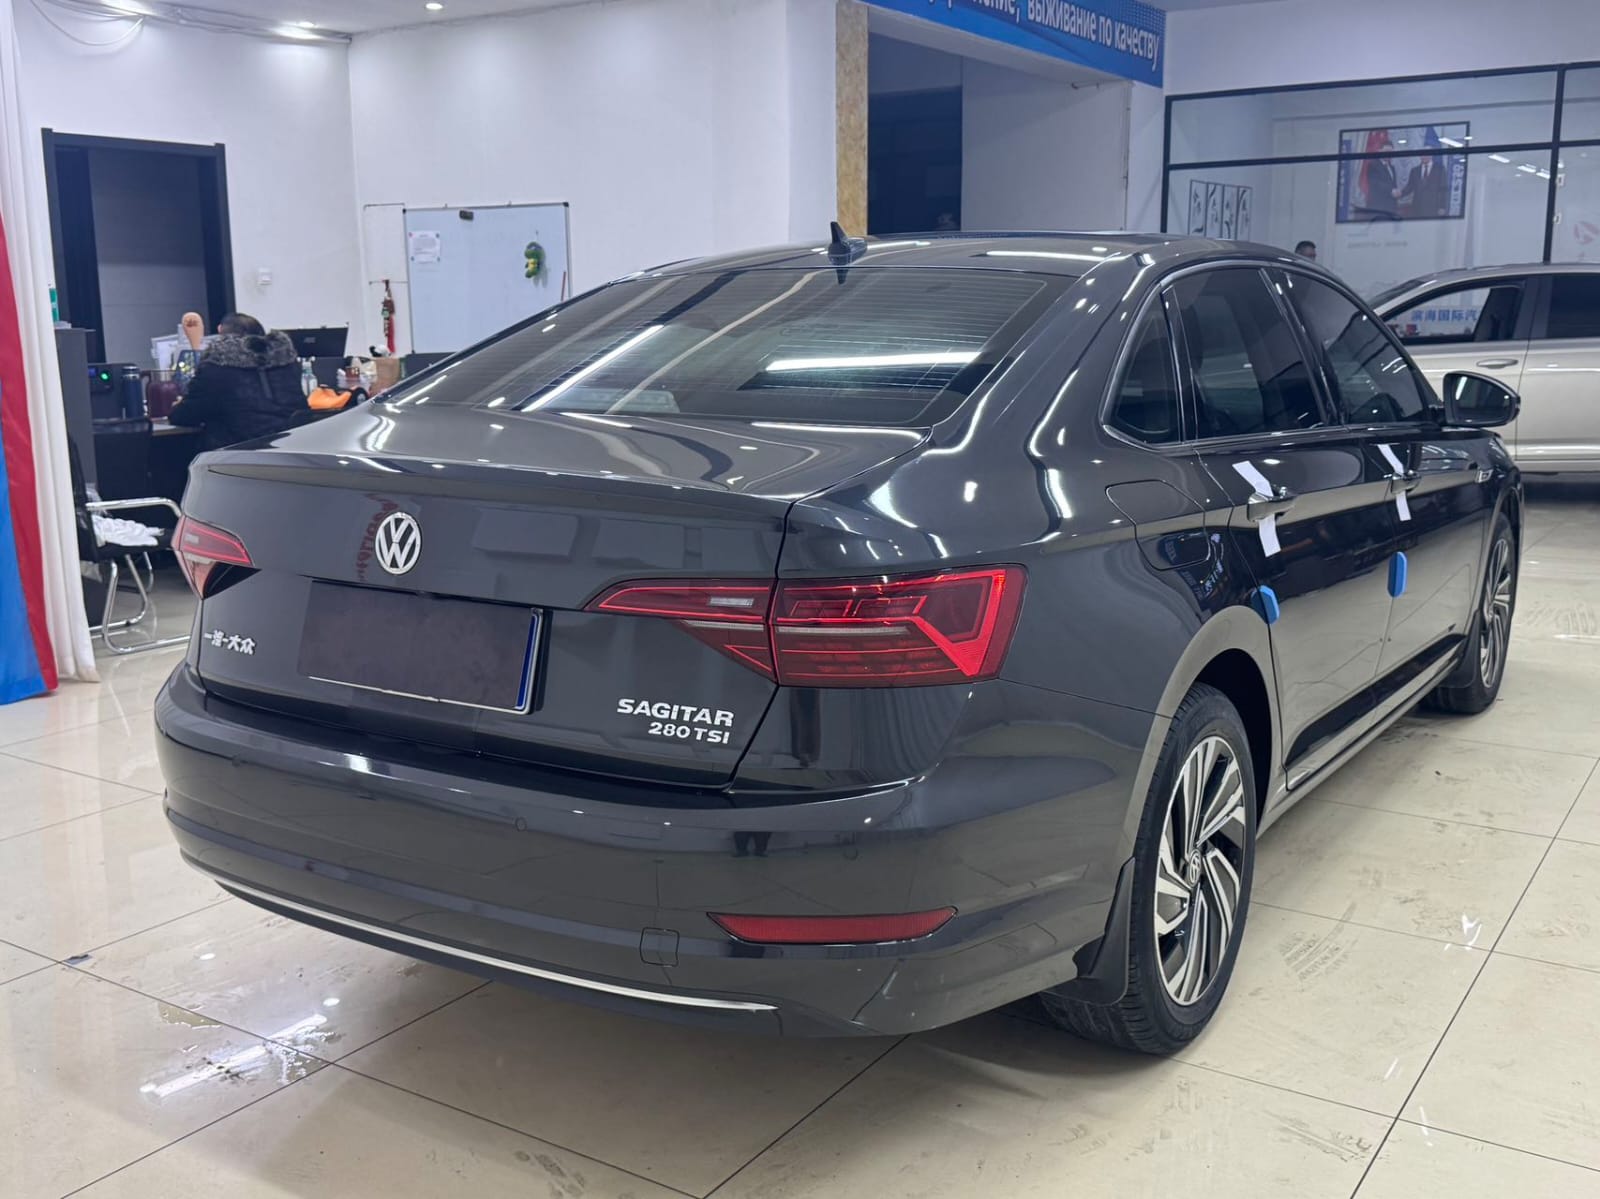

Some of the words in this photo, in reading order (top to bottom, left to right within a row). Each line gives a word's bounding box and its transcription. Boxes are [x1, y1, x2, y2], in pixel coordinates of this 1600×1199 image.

[1028, 0, 1097, 41] выживание
[1099, 15, 1113, 47] по
[1114, 21, 1160, 73] качеству
[375, 511, 422, 575] VW
[617, 698, 735, 727] SAGITAR
